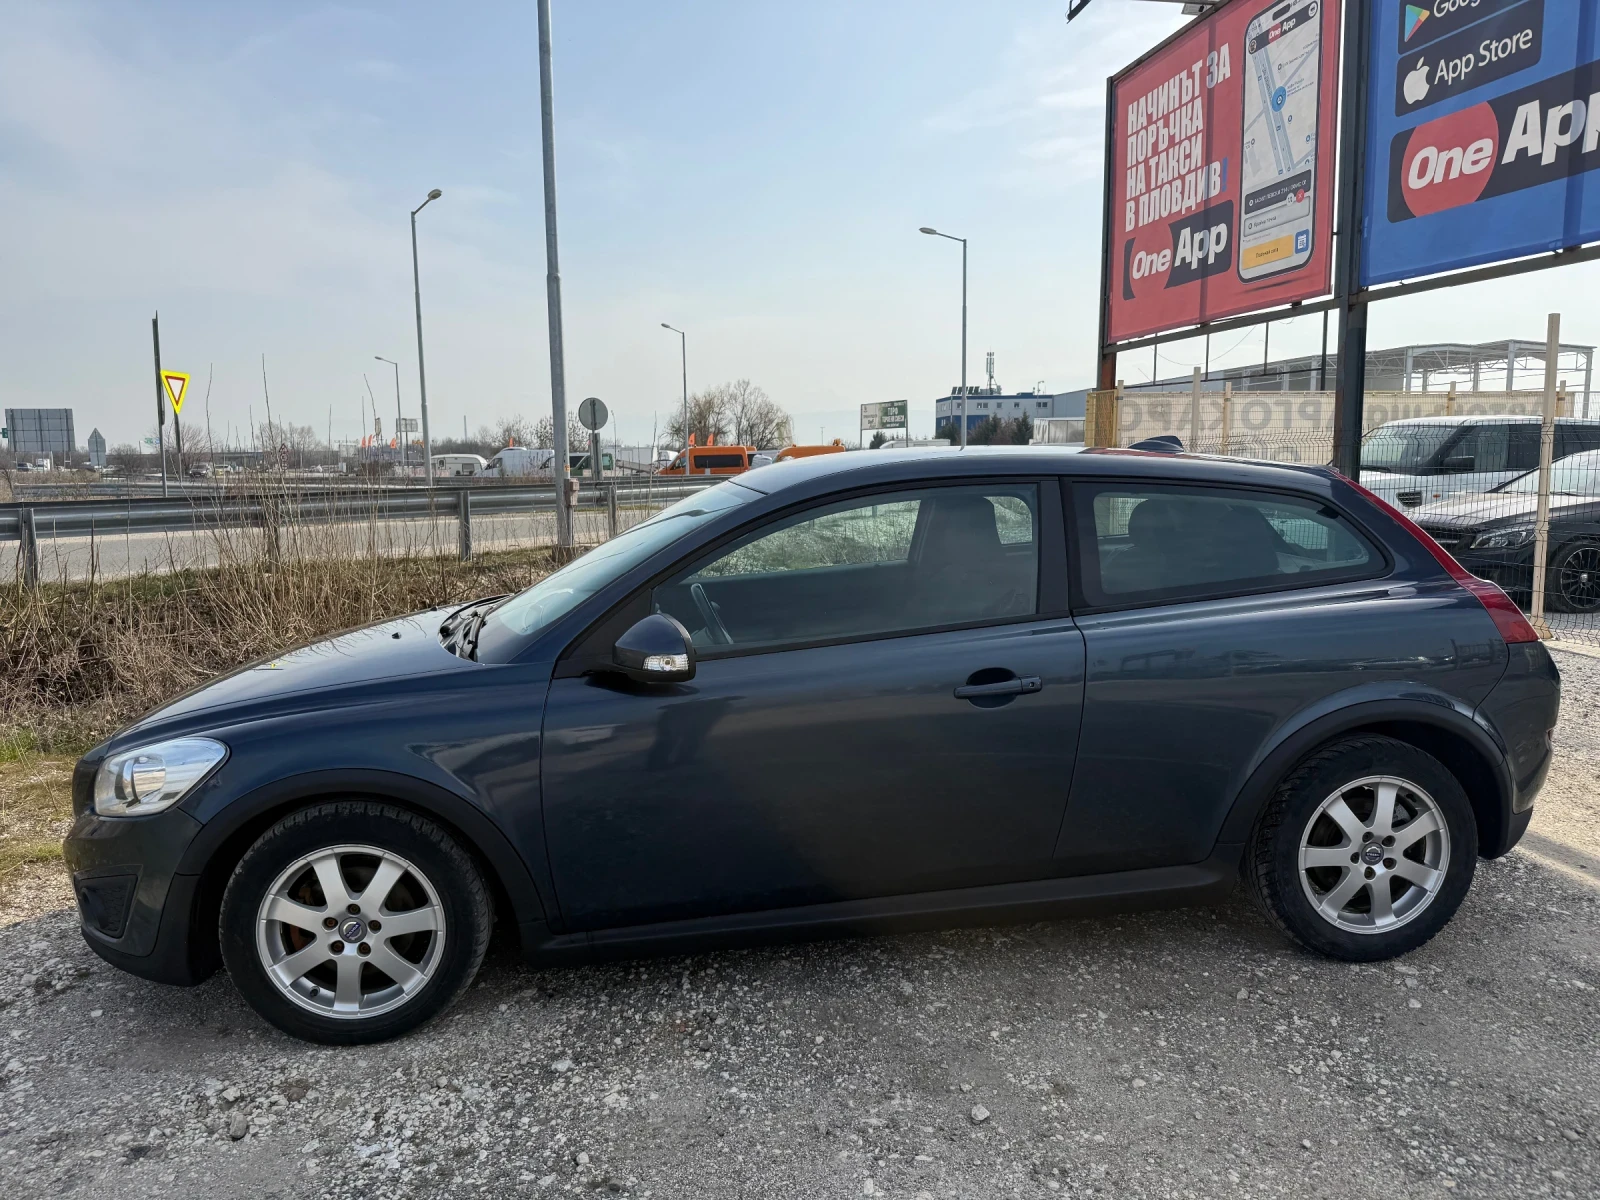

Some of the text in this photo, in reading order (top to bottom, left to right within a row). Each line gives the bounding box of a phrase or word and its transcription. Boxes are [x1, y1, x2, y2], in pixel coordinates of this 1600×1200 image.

[1282, 18, 1296, 32] App
[1434, 28, 1533, 86] App Store
[1127, 59, 1203, 136] НАЧИНЪТ
[1206, 42, 1231, 89] ЗА
[1127, 96, 1204, 169] ПОРЪЧКА
[1408, 138, 1494, 190] One
[1125, 200, 1136, 233] В
[1138, 156, 1229, 228] ПЛОВДИВ!
[1127, 132, 1203, 201] НА ТАКСИ
[1132, 222, 1228, 280] One App
